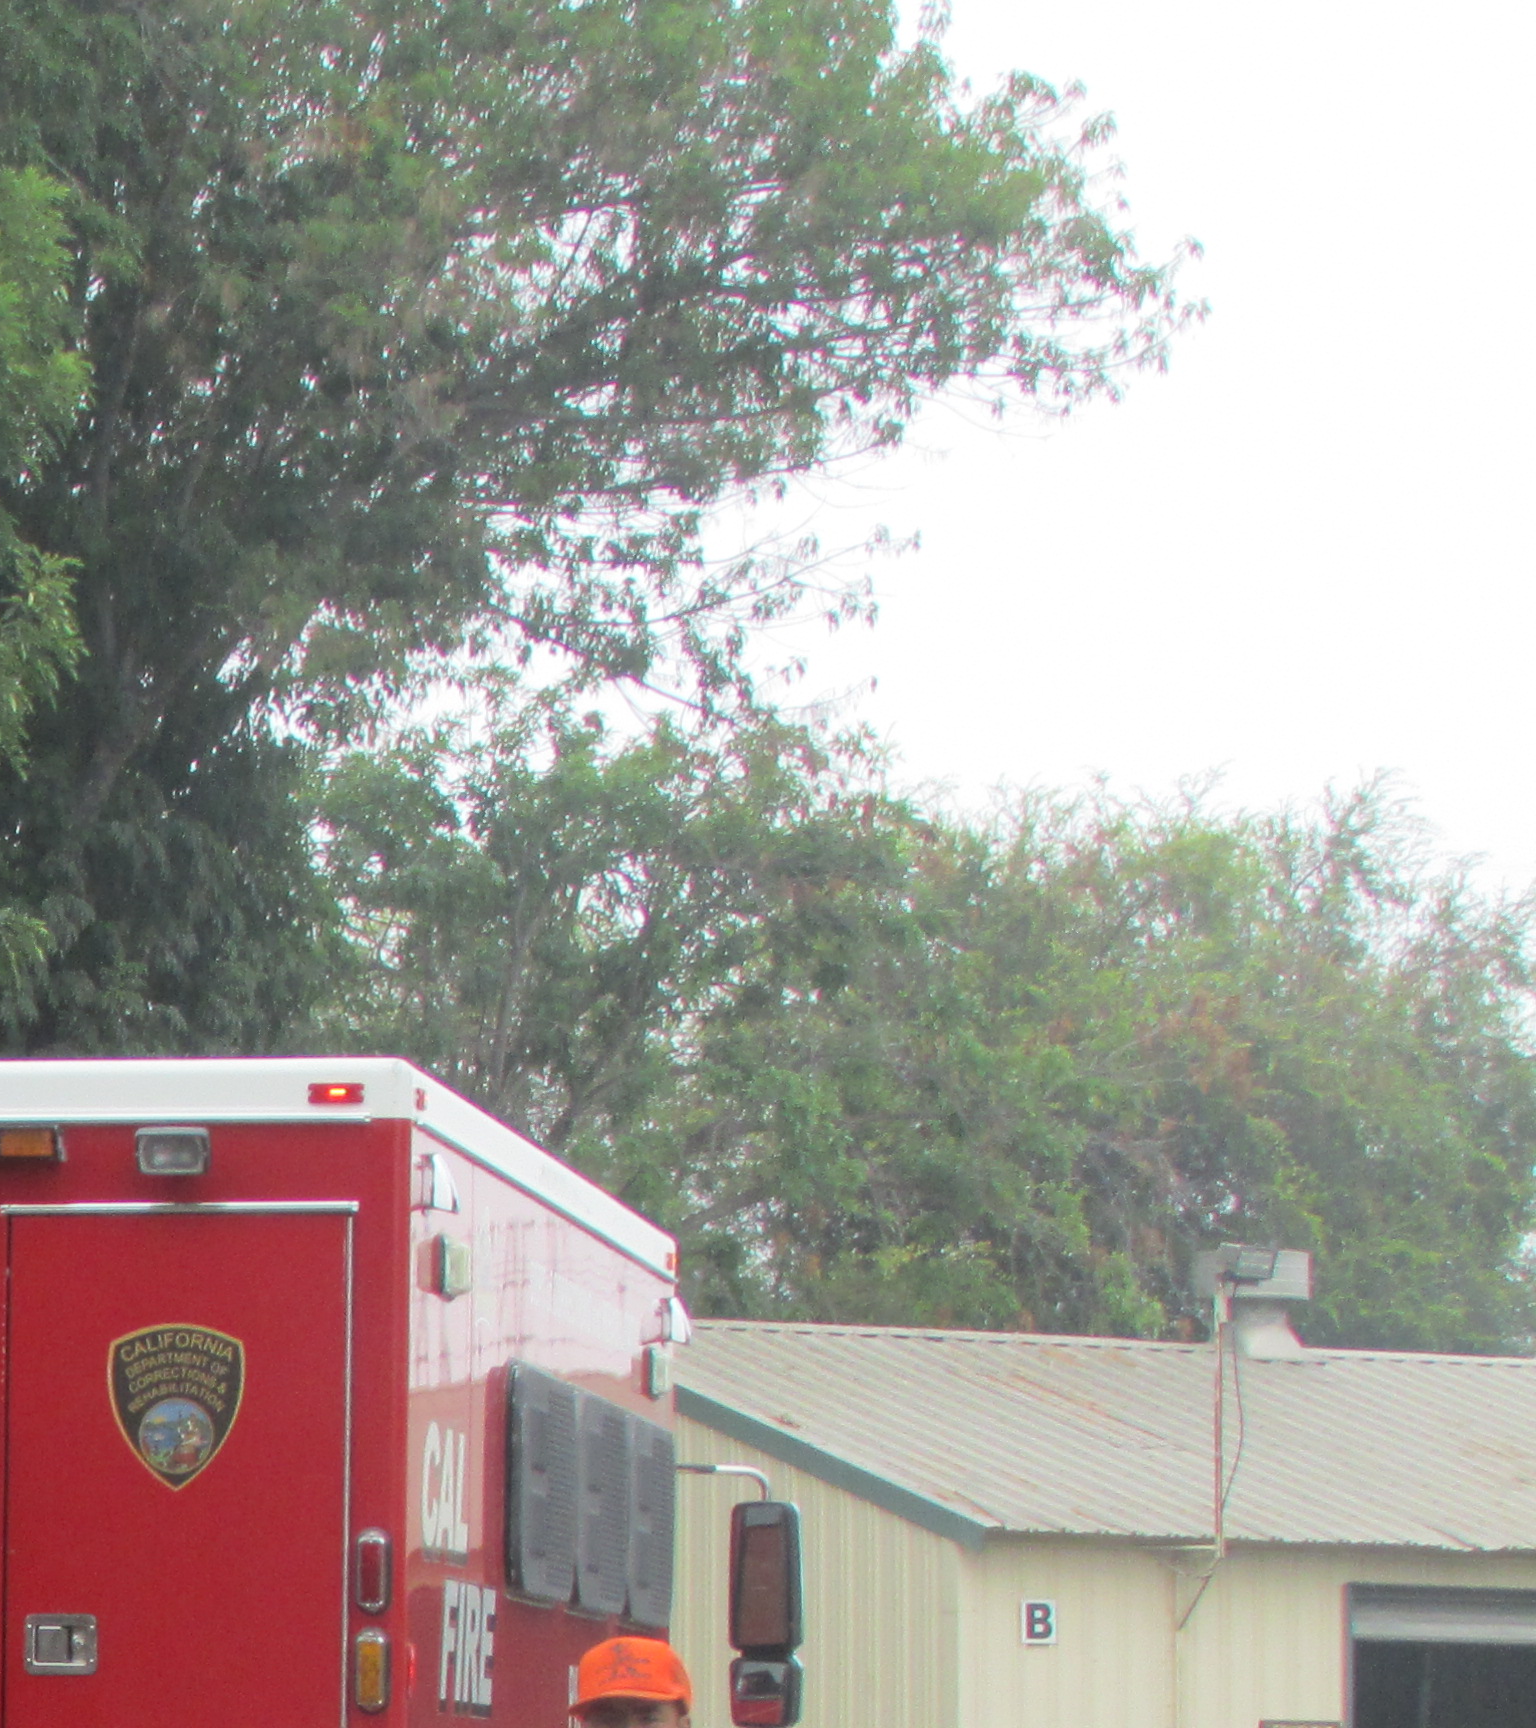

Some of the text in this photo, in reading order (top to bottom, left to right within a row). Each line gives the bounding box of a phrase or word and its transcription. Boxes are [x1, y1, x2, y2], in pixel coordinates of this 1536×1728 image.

[120, 1332, 234, 1362] CALIFORNIA
[125, 1352, 229, 1379] DEPARTMENT OF
[128, 1367, 217, 1394] CORRECTIONS
[128, 1382, 226, 1414] REHABILITATION
[421, 1420, 469, 1556] CAL
[1026, 1603, 1053, 1639] B
[439, 1579, 497, 1709] FIRE
